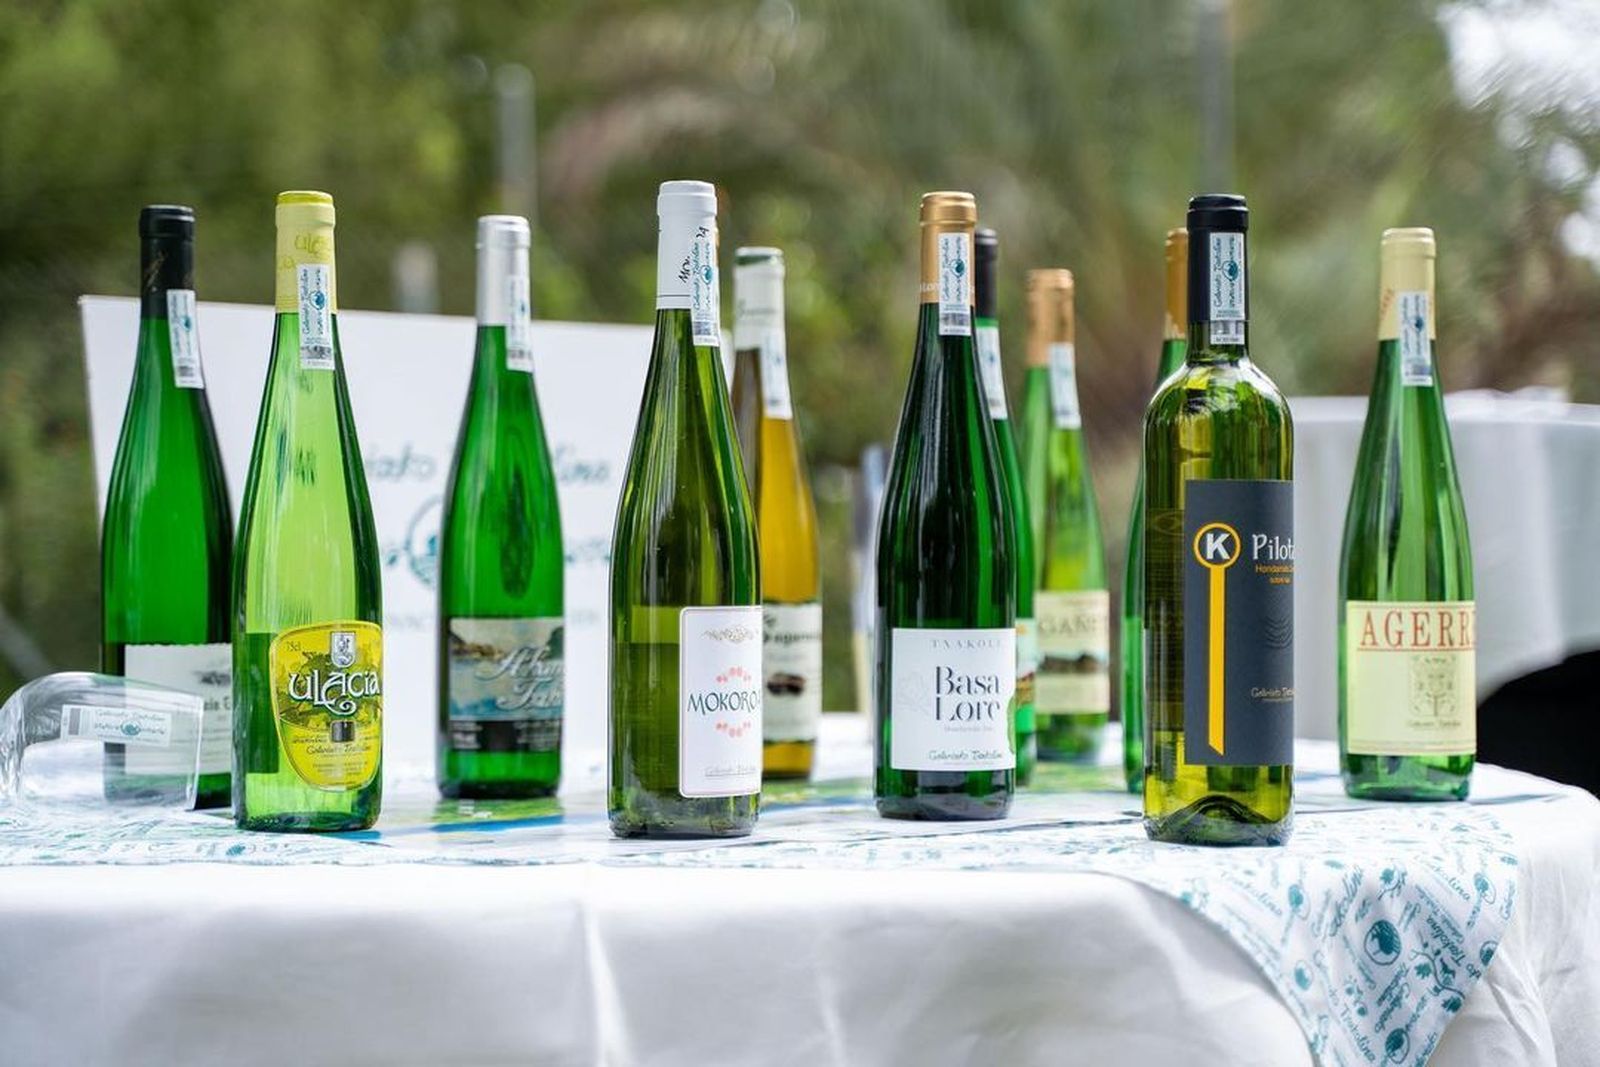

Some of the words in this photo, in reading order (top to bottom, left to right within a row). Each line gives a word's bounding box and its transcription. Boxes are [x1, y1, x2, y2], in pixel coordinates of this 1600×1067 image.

[1205, 533, 1230, 560] K
[1360, 610, 1476, 647] AGERR
[935, 666, 999, 696] Basa
[687, 689, 760, 715] MOKORO
[935, 697, 1000, 722] Lore
